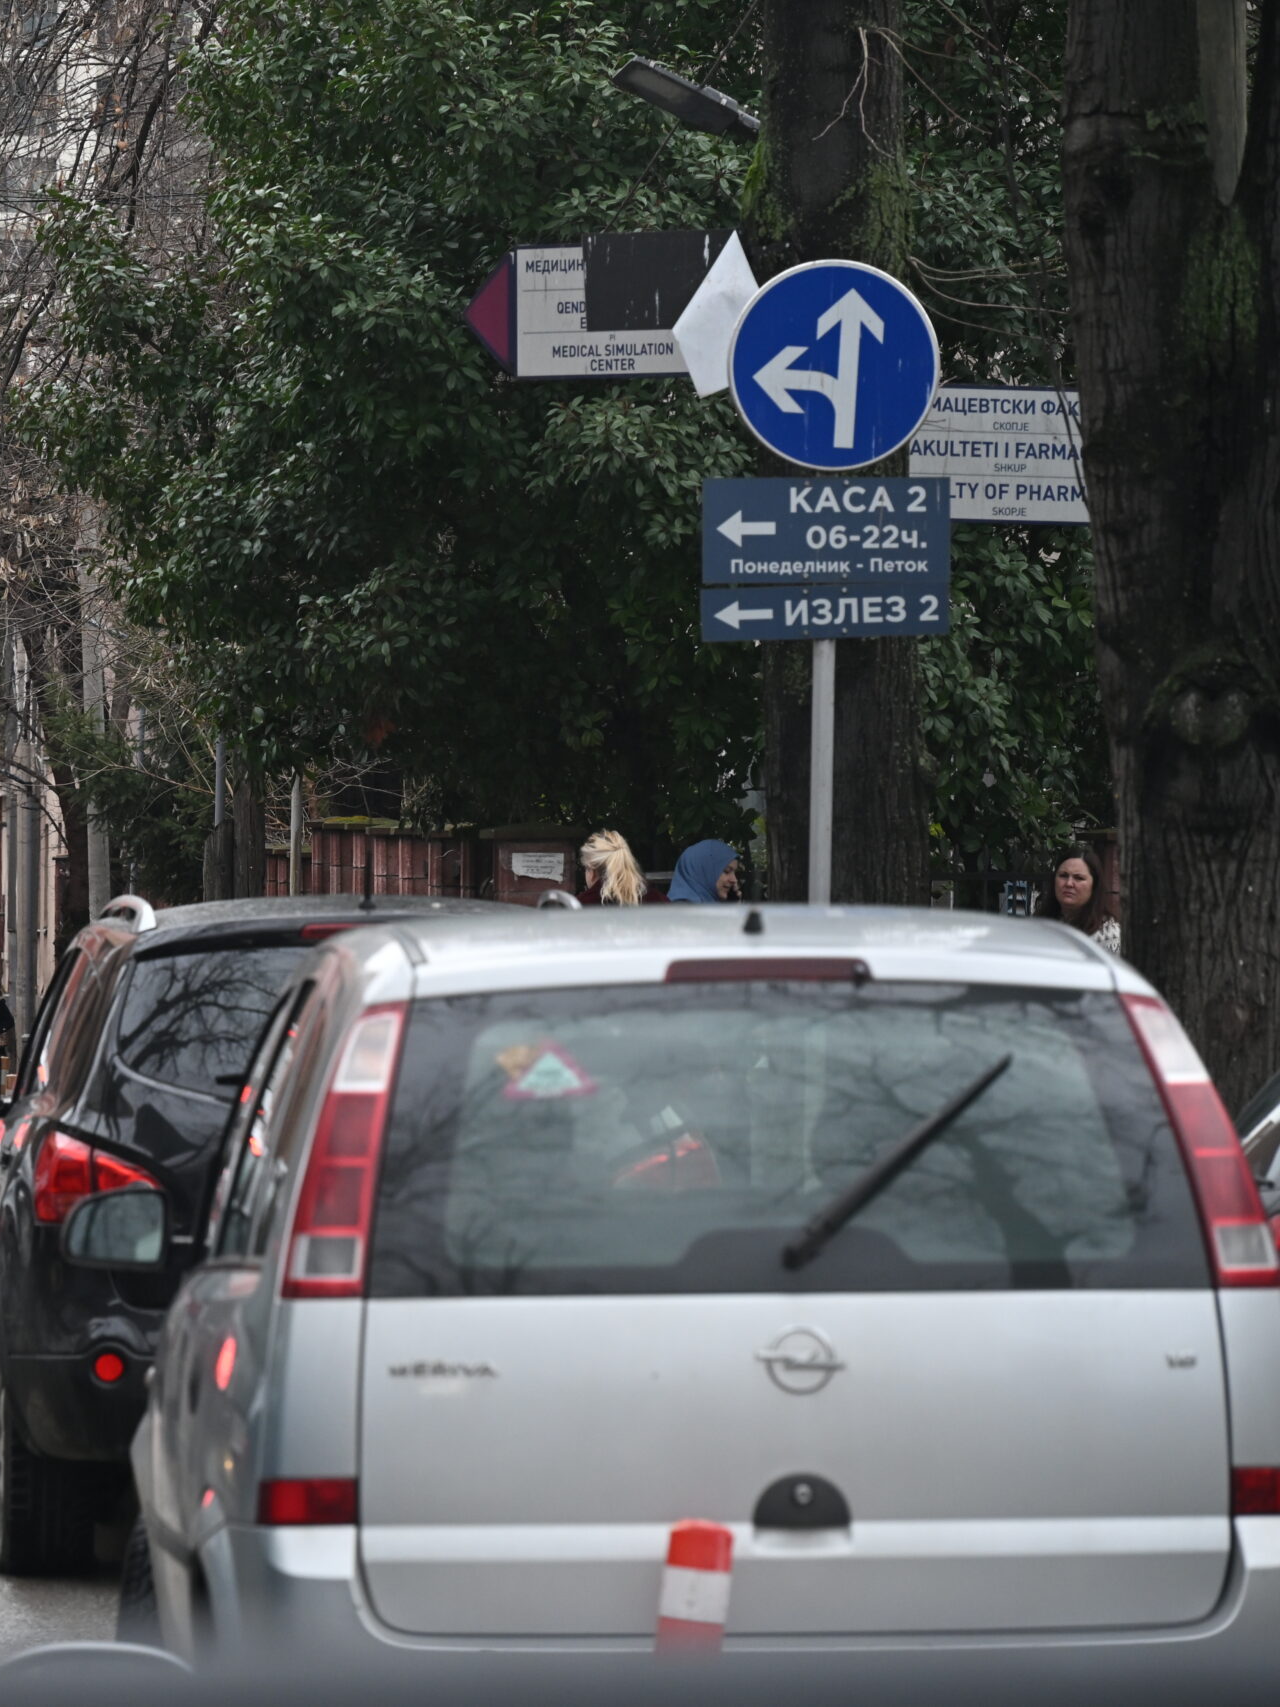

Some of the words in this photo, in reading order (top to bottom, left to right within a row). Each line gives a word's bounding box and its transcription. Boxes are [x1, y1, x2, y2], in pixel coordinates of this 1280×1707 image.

[552, 344, 602, 358] MEDICAL
[605, 342, 674, 357] SIMULATION
[590, 358, 635, 372] CENTER
[1041, 399, 1080, 416] ФАК
[992, 421, 1030, 432] СКОПЈЕ
[910, 439, 999, 459] AKULTETI
[1004, 442, 1009, 459] I
[1015, 442, 1083, 461] FARMA
[993, 463, 1027, 473] SHKUP
[789, 486, 895, 514] КАСА
[906, 486, 927, 512] 2
[984, 483, 1010, 500] OF
[1016, 483, 1086, 502] PHARM
[992, 507, 1027, 517] SKOPJE
[806, 525, 928, 550] 06-22ч.
[730, 558, 851, 576] Понеделник
[870, 558, 929, 573] Петок
[784, 595, 907, 627] ИЗЛЕЗ
[919, 594, 939, 622] 2
